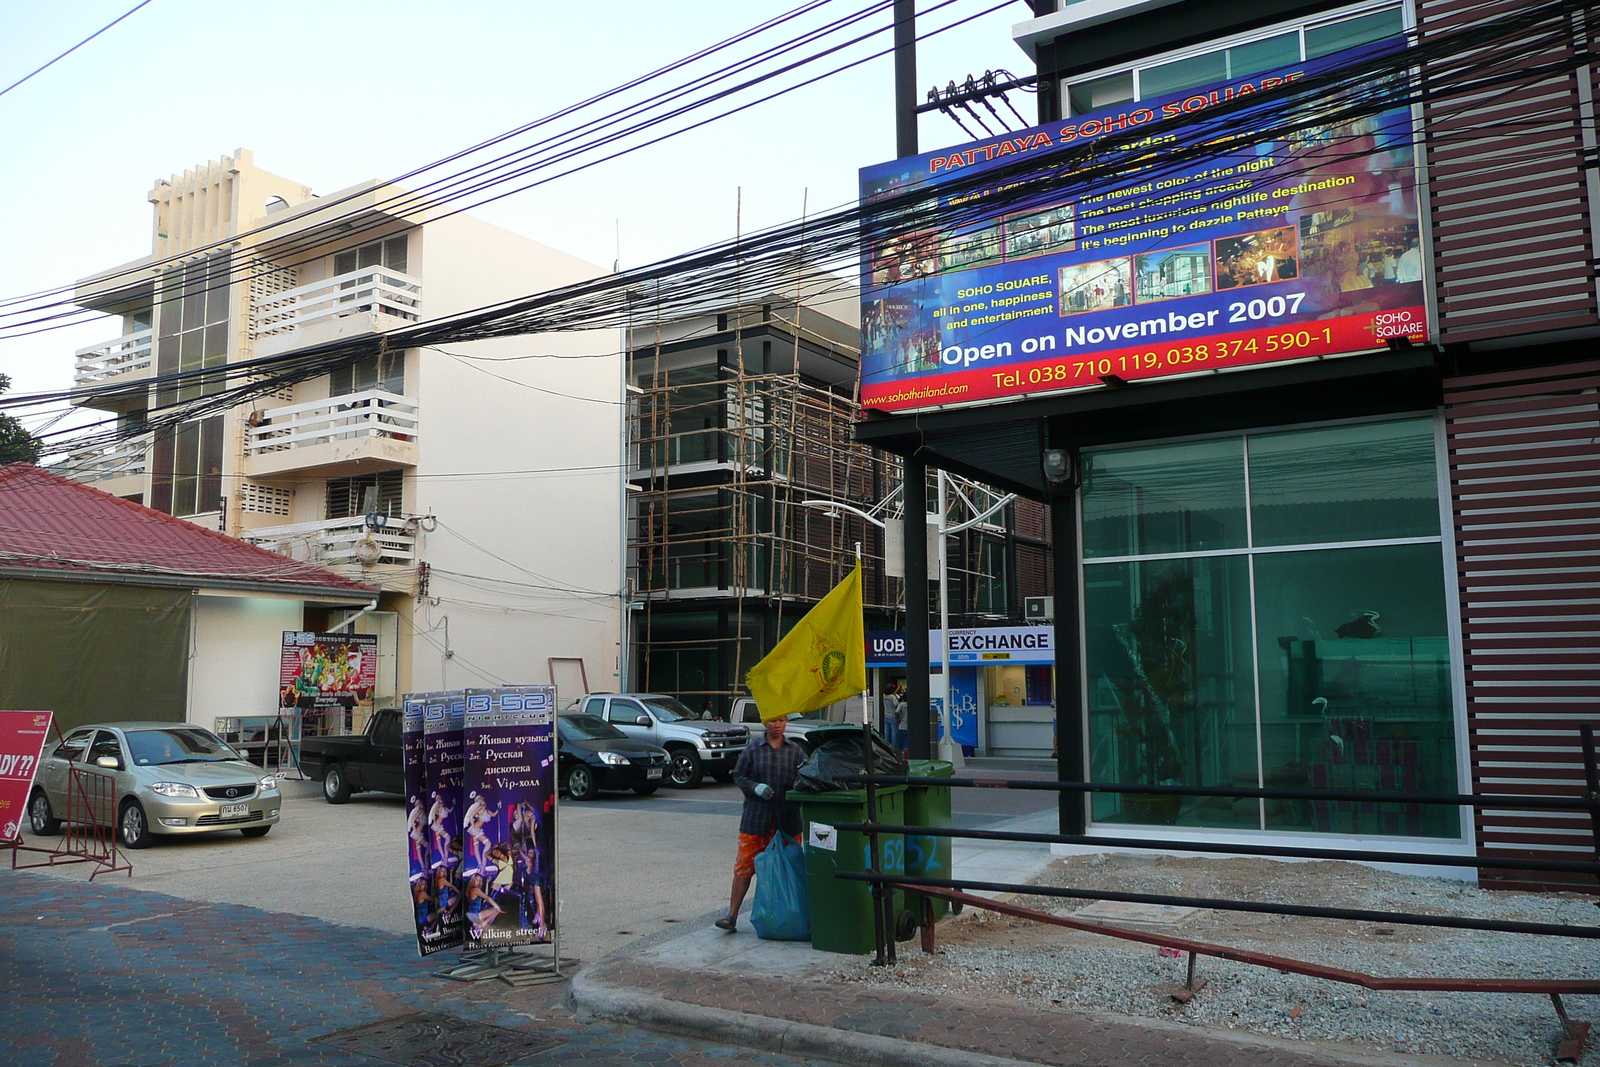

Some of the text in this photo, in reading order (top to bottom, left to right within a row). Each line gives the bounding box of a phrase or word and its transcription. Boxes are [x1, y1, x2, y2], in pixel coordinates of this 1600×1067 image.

[930, 132, 1053, 173] PATTAYA
[1060, 108, 1154, 142] SOHO
[1107, 183, 1153, 199] newest
[1156, 176, 1190, 189] color
[1194, 170, 1208, 181] of
[1211, 167, 1233, 178] the
[1237, 157, 1274, 173] night
[1081, 225, 1105, 235] The
[1108, 216, 1141, 229] most
[1211, 191, 1269, 211] nightlife
[1272, 175, 1355, 199] destination
[1139, 190, 1201, 209] shopping
[1081, 204, 1289, 249] It's beginning to dazzle Pattaya
[957, 274, 1052, 299] SOHO SQUARE,
[933, 290, 1053, 318] all in one, happiness
[946, 304, 1054, 330] and entertainment
[1376, 311, 1411, 325] SOHO
[942, 293, 1306, 367] Open on November 2007
[1376, 322, 1423, 337] SQUARE
[992, 371, 1026, 388] Tel.
[1029, 364, 1067, 384] 038
[1072, 358, 1111, 378] 710
[1215, 337, 1259, 359] 374
[1266, 327, 1332, 352] 590-1
[863, 383, 969, 406] www.sohothailand.com
[284, 632, 315, 646] B-52
[873, 639, 905, 652] UOB
[949, 633, 1049, 650] EXCHANGE
[467, 693, 547, 713] B-52
[479, 734, 511, 745] Живая
[514, 735, 549, 744] музыка
[485, 749, 523, 761] Русская
[484, 765, 531, 776] дискотека
[469, 927, 512, 940] Walking
